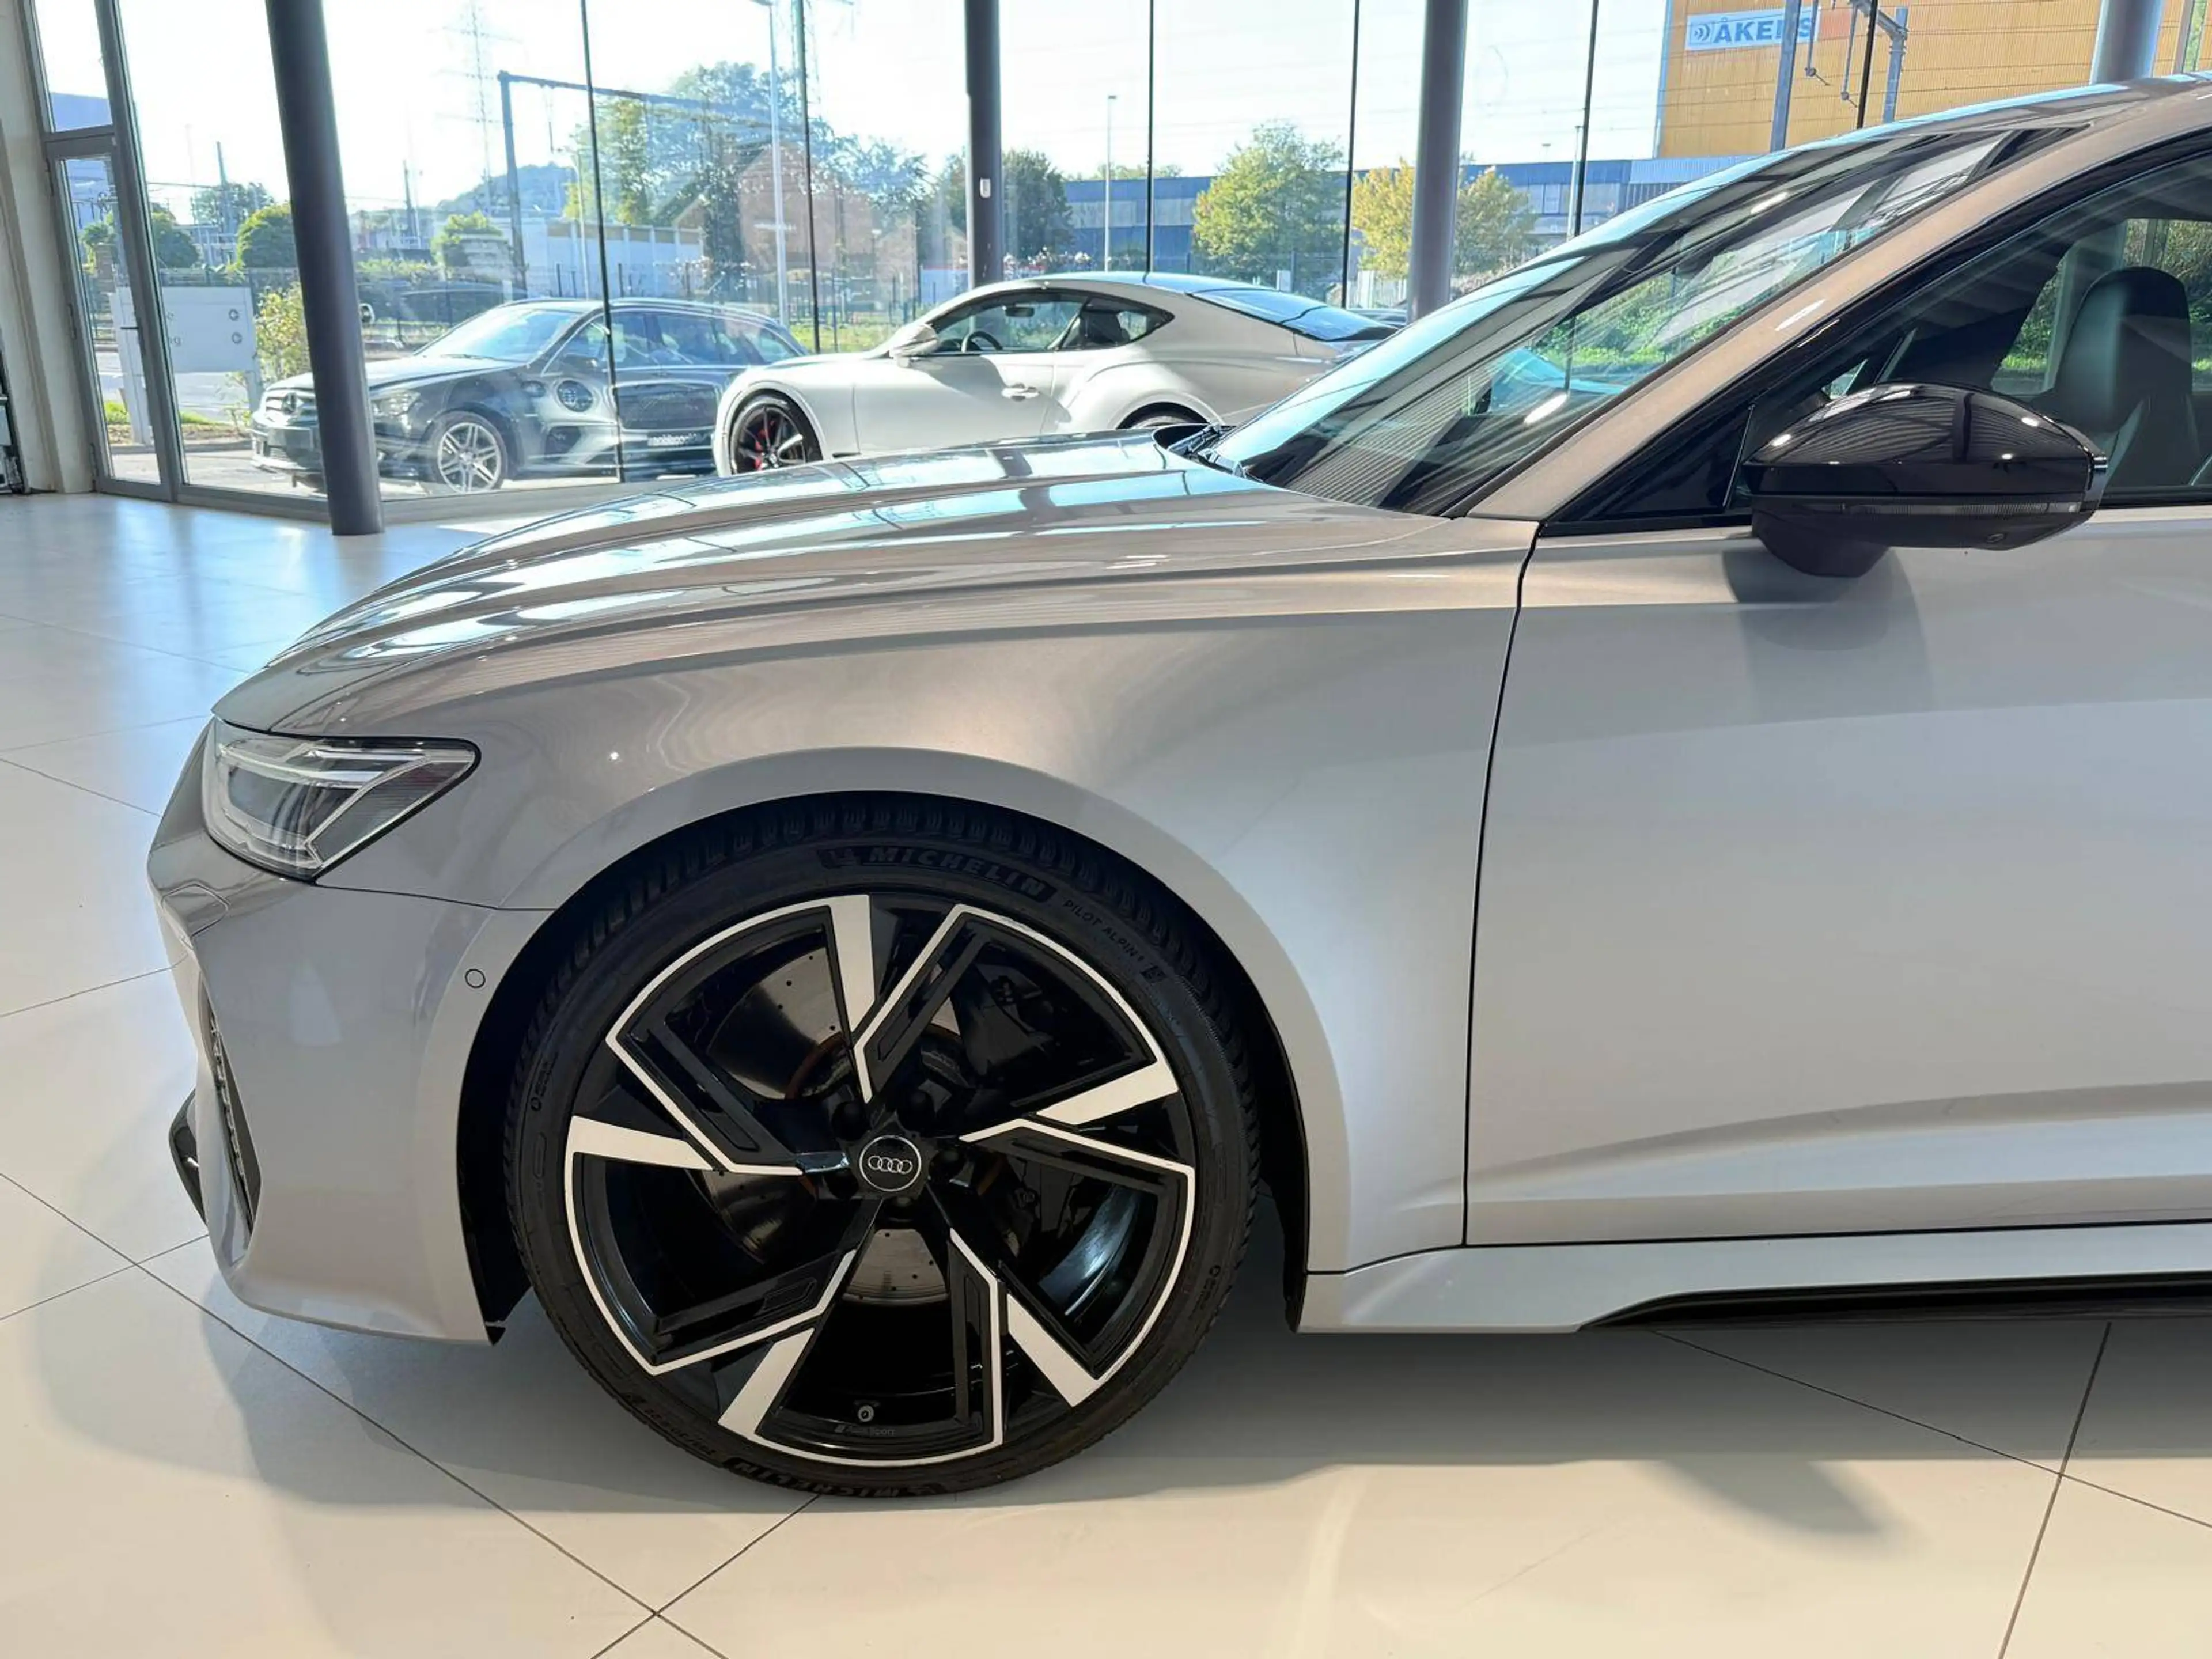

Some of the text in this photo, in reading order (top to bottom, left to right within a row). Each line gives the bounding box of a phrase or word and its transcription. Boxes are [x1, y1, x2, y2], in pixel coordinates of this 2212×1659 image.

[869, 846, 1045, 897] MICHELIN
[1062, 899, 1103, 926] PILOT
[733, 1461, 899, 1497] MICHELIN
